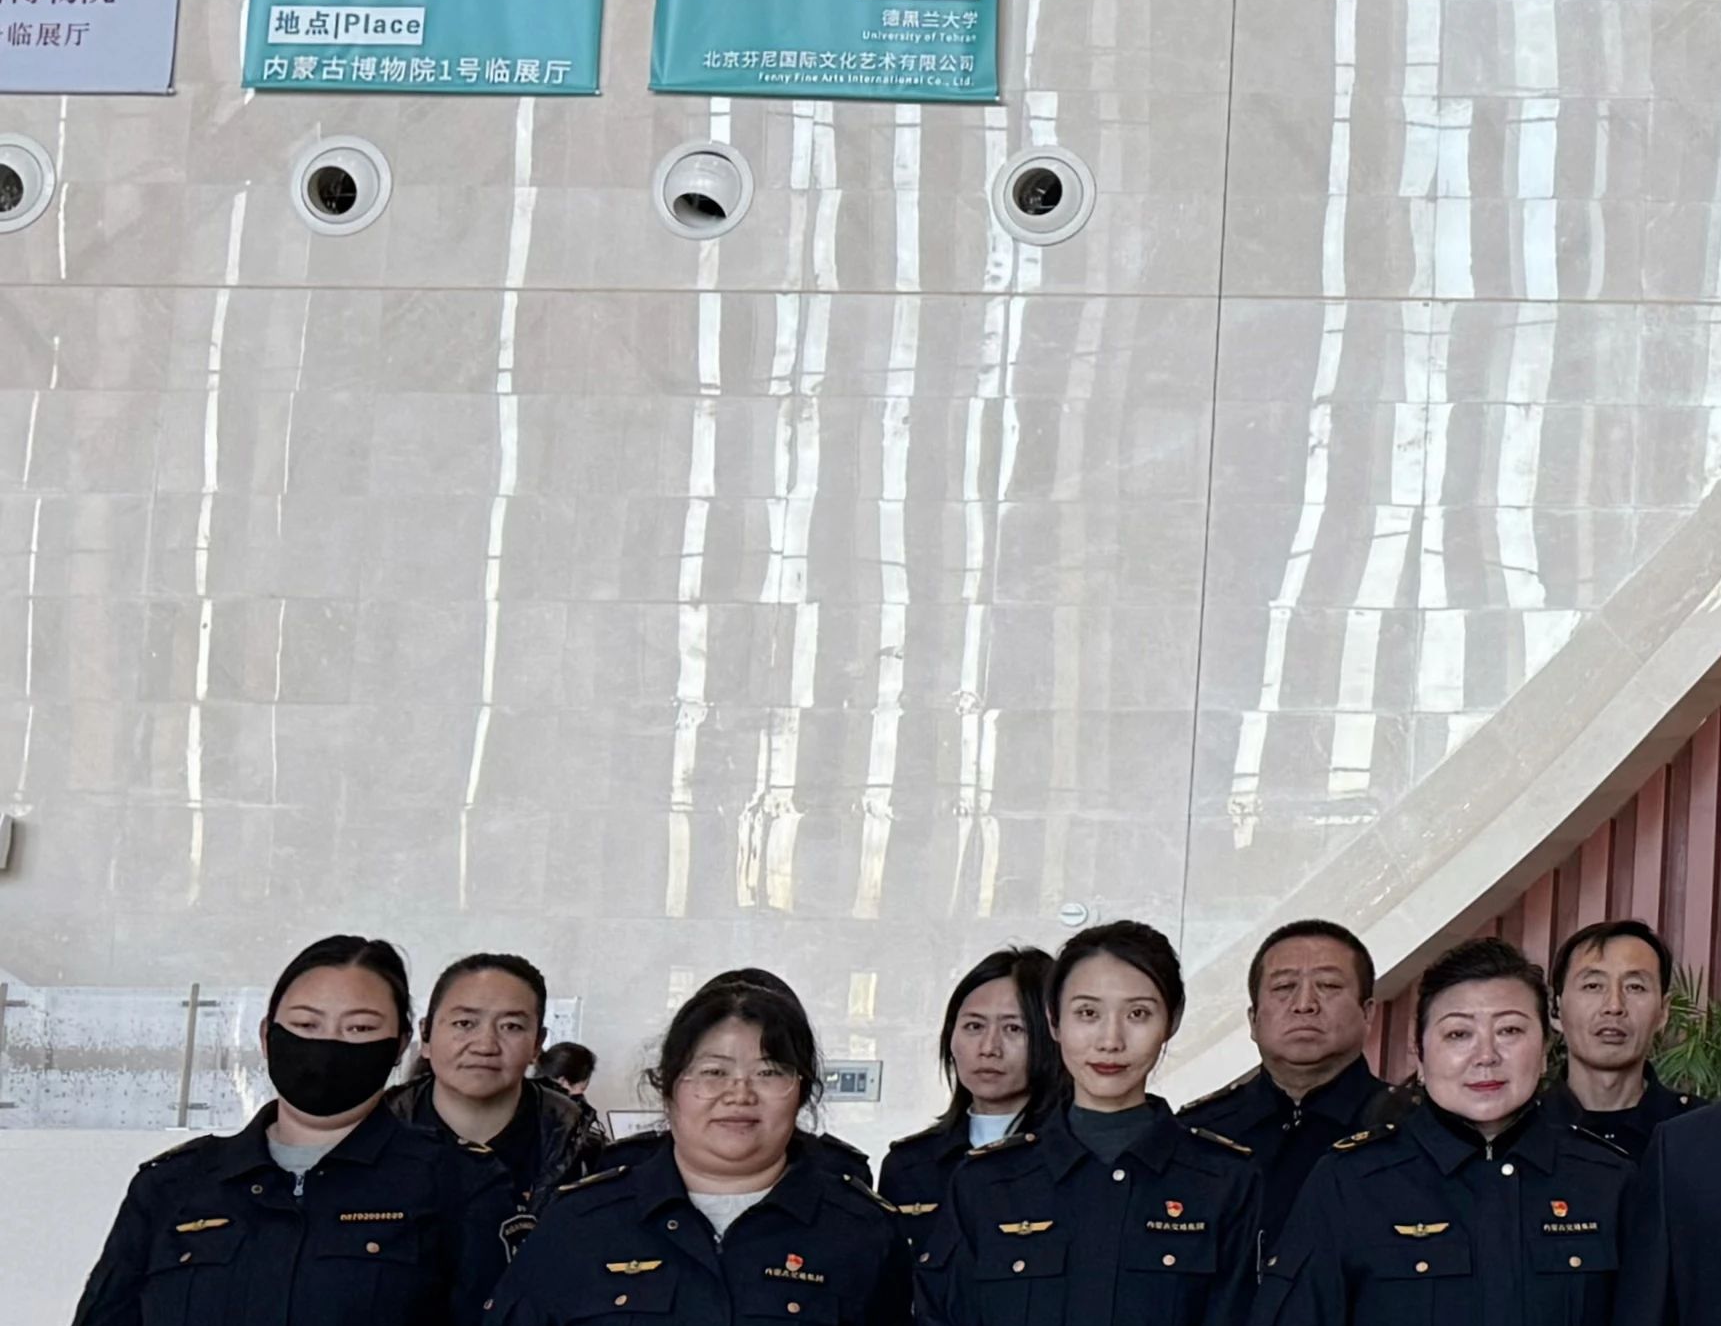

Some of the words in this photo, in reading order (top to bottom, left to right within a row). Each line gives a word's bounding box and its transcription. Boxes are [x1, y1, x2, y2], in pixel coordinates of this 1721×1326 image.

[882, 8, 979, 30] 德黑兰大学
[0, 23, 90, 48] 临展厅
[862, 30, 921, 42] University
[923, 31, 936, 43] of
[262, 55, 573, 85] 内蒙古博物院1号临展厅
[703, 51, 975, 73] 北京芬尼国际文化艺术有限公司
[794, 74, 818, 84] Fine
[822, 74, 844, 84] Arts
